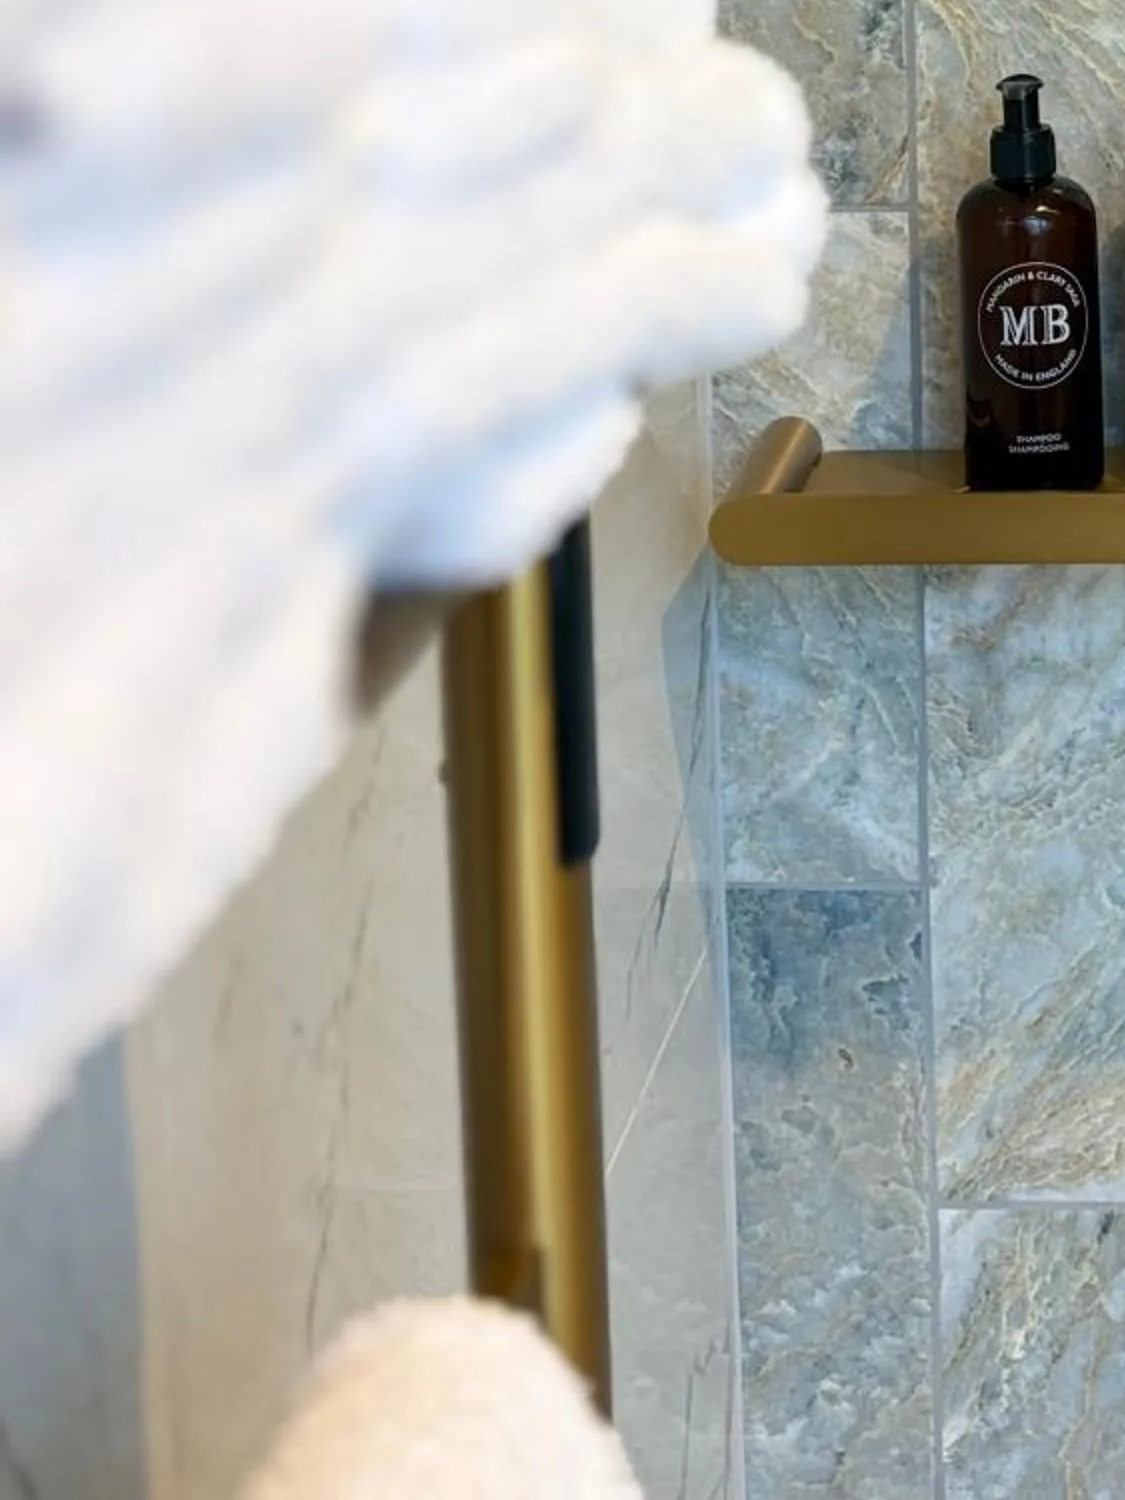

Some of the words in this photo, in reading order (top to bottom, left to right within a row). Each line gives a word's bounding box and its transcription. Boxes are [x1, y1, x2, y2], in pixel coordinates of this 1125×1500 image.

[985, 272, 1025, 313] MANDARIN
[1027, 271, 1035, 280] &
[1036, 271, 1067, 286] CLARY
[999, 303, 1070, 346] MB
[995, 353, 1019, 378] MADE
[1021, 371, 1033, 381] IN
[1035, 348, 1077, 384] ENGLAND
